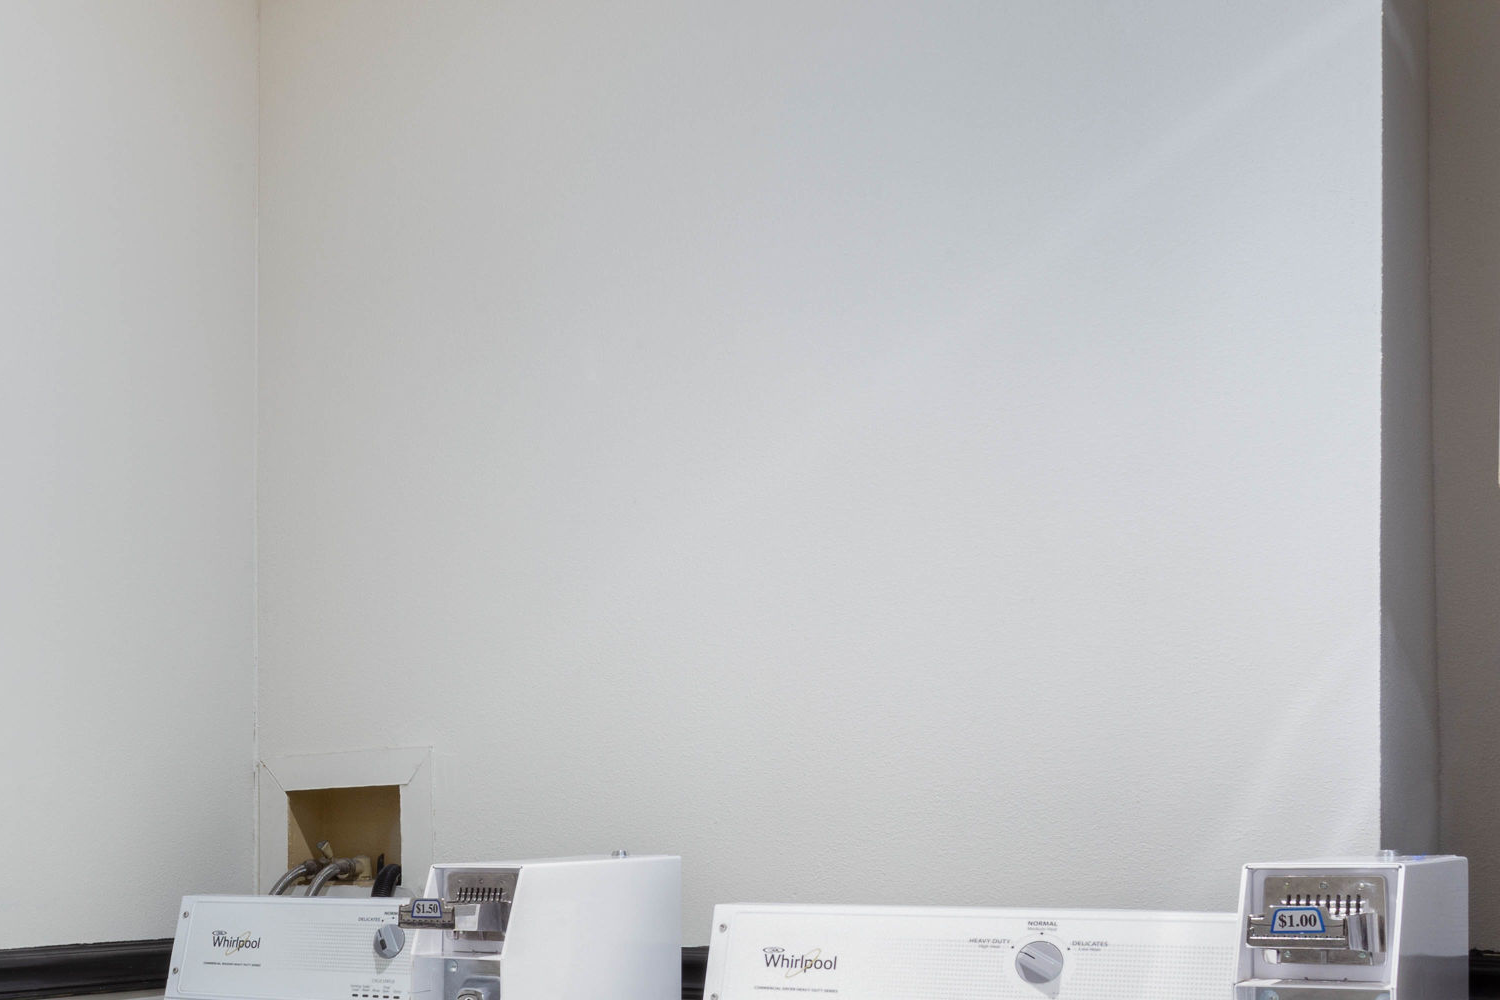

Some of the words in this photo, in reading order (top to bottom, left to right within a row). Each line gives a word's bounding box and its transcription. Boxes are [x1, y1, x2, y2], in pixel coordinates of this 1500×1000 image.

[415, 903, 438, 914] $1.50
[1278, 913, 1317, 928] $1.00
[212, 935, 261, 951] Whirlpool
[764, 953, 837, 973] Whirlpool
